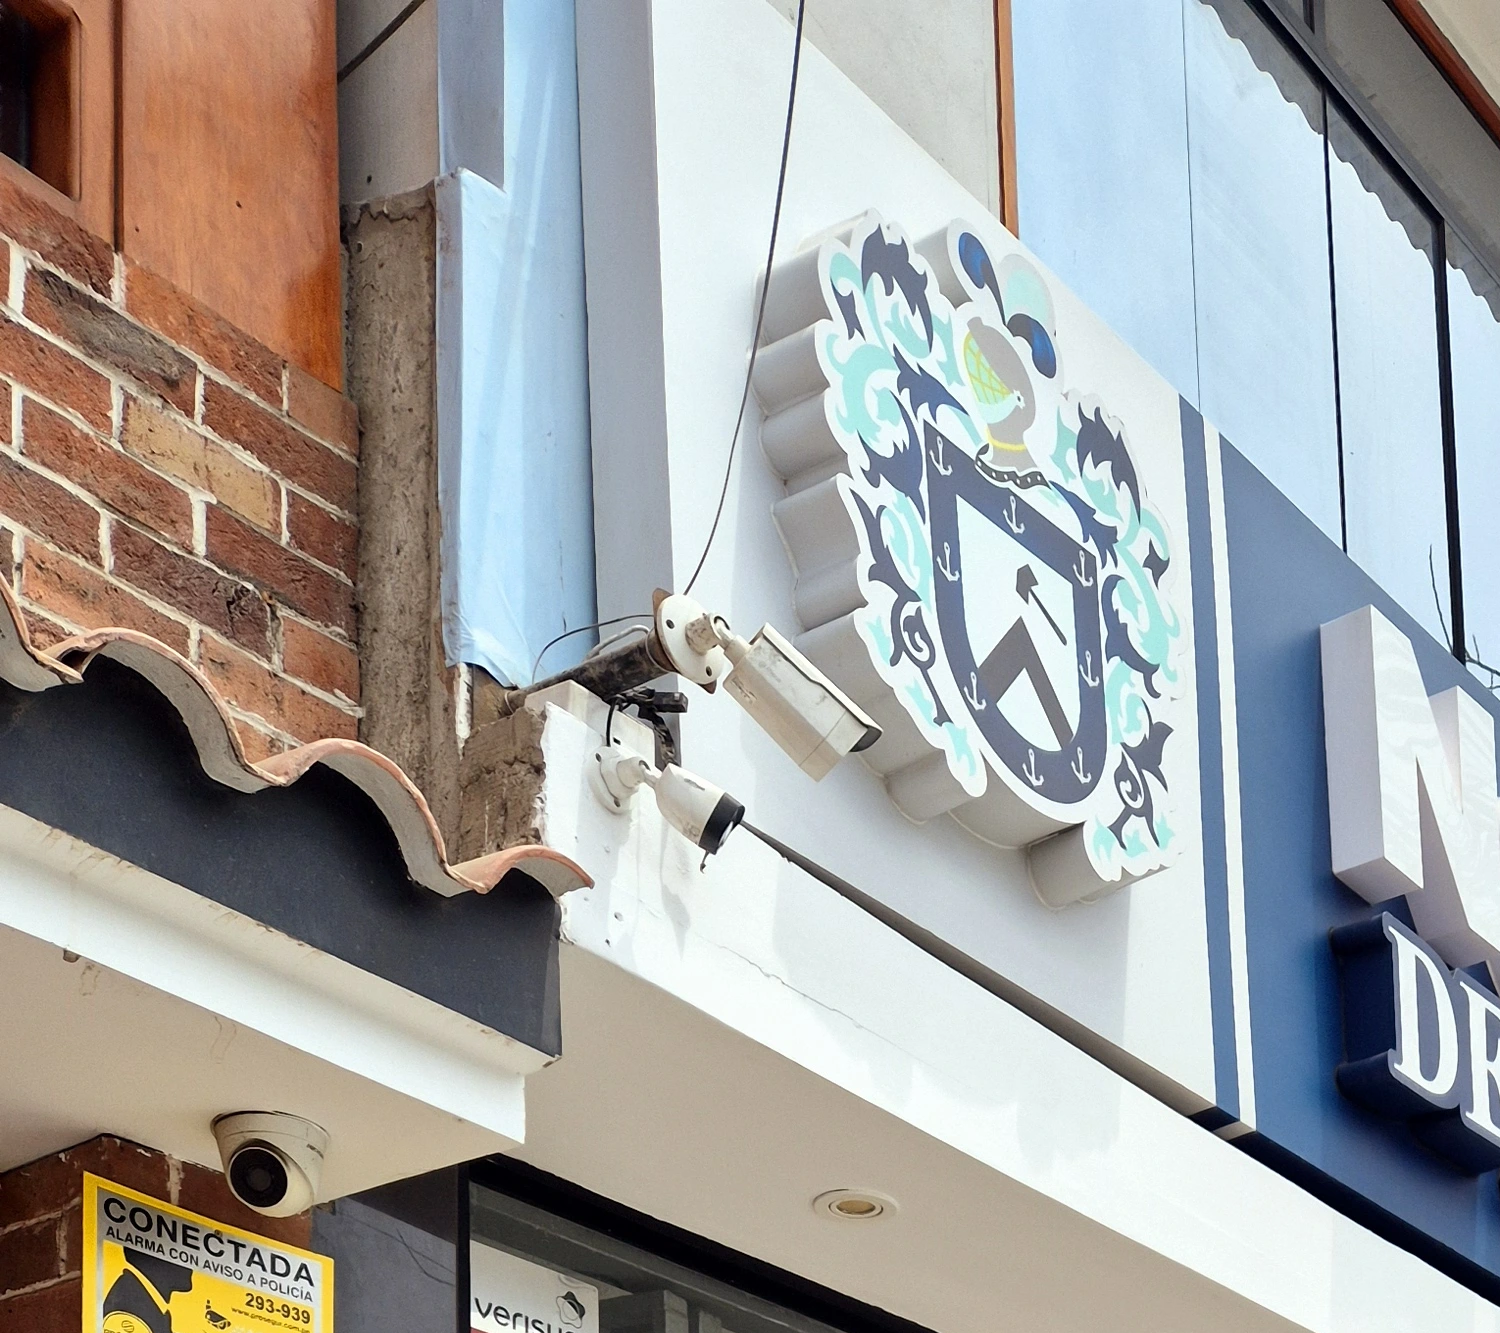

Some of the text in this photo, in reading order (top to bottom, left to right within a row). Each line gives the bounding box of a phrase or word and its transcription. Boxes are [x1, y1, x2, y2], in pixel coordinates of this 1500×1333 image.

[103, 1198, 315, 1287] CONECTADA
[106, 1226, 313, 1302] ALARMA CON AVISO A POLICÍA
[245, 1293, 311, 1324] 293-939
